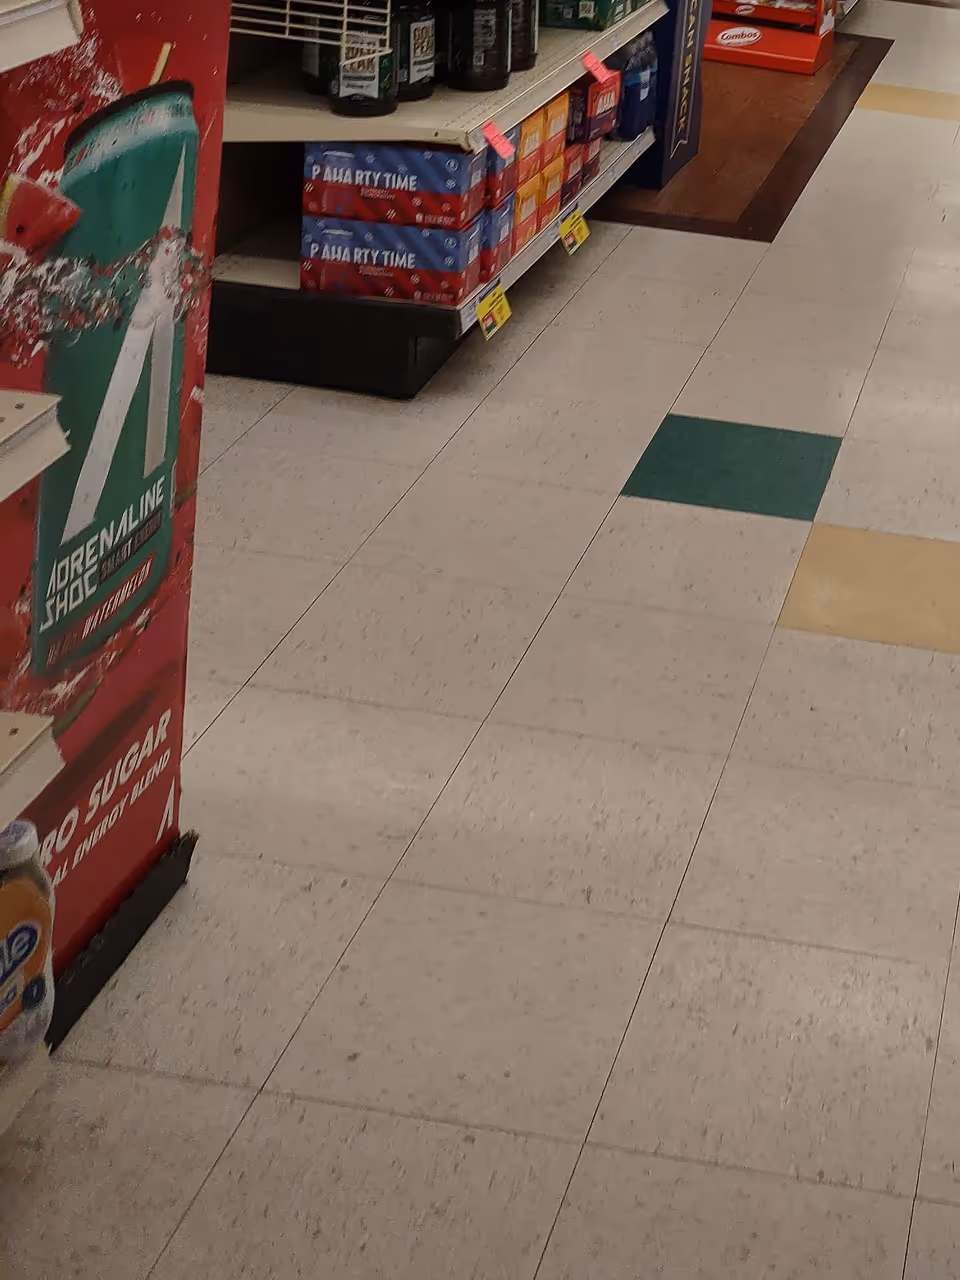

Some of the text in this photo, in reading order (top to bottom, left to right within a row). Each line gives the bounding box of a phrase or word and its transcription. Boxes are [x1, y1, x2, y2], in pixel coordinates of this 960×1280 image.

[720, 29, 760, 42] Combos
[676, 53, 694, 134] SNACK
[323, 167, 353, 185] AHA
[355, 169, 381, 187] RTY
[383, 172, 418, 192] TIME
[321, 245, 352, 262] AHA
[353, 247, 379, 266] RTY
[381, 250, 416, 269] TIME
[47, 475, 165, 599] ADRENALINE
[40, 568, 99, 632] SHOC
[82, 557, 153, 640] WATERMELON
[85, 708, 172, 824] SUGAR
[72, 791, 130, 871] ENERGY
[130, 748, 172, 806] BLEND
